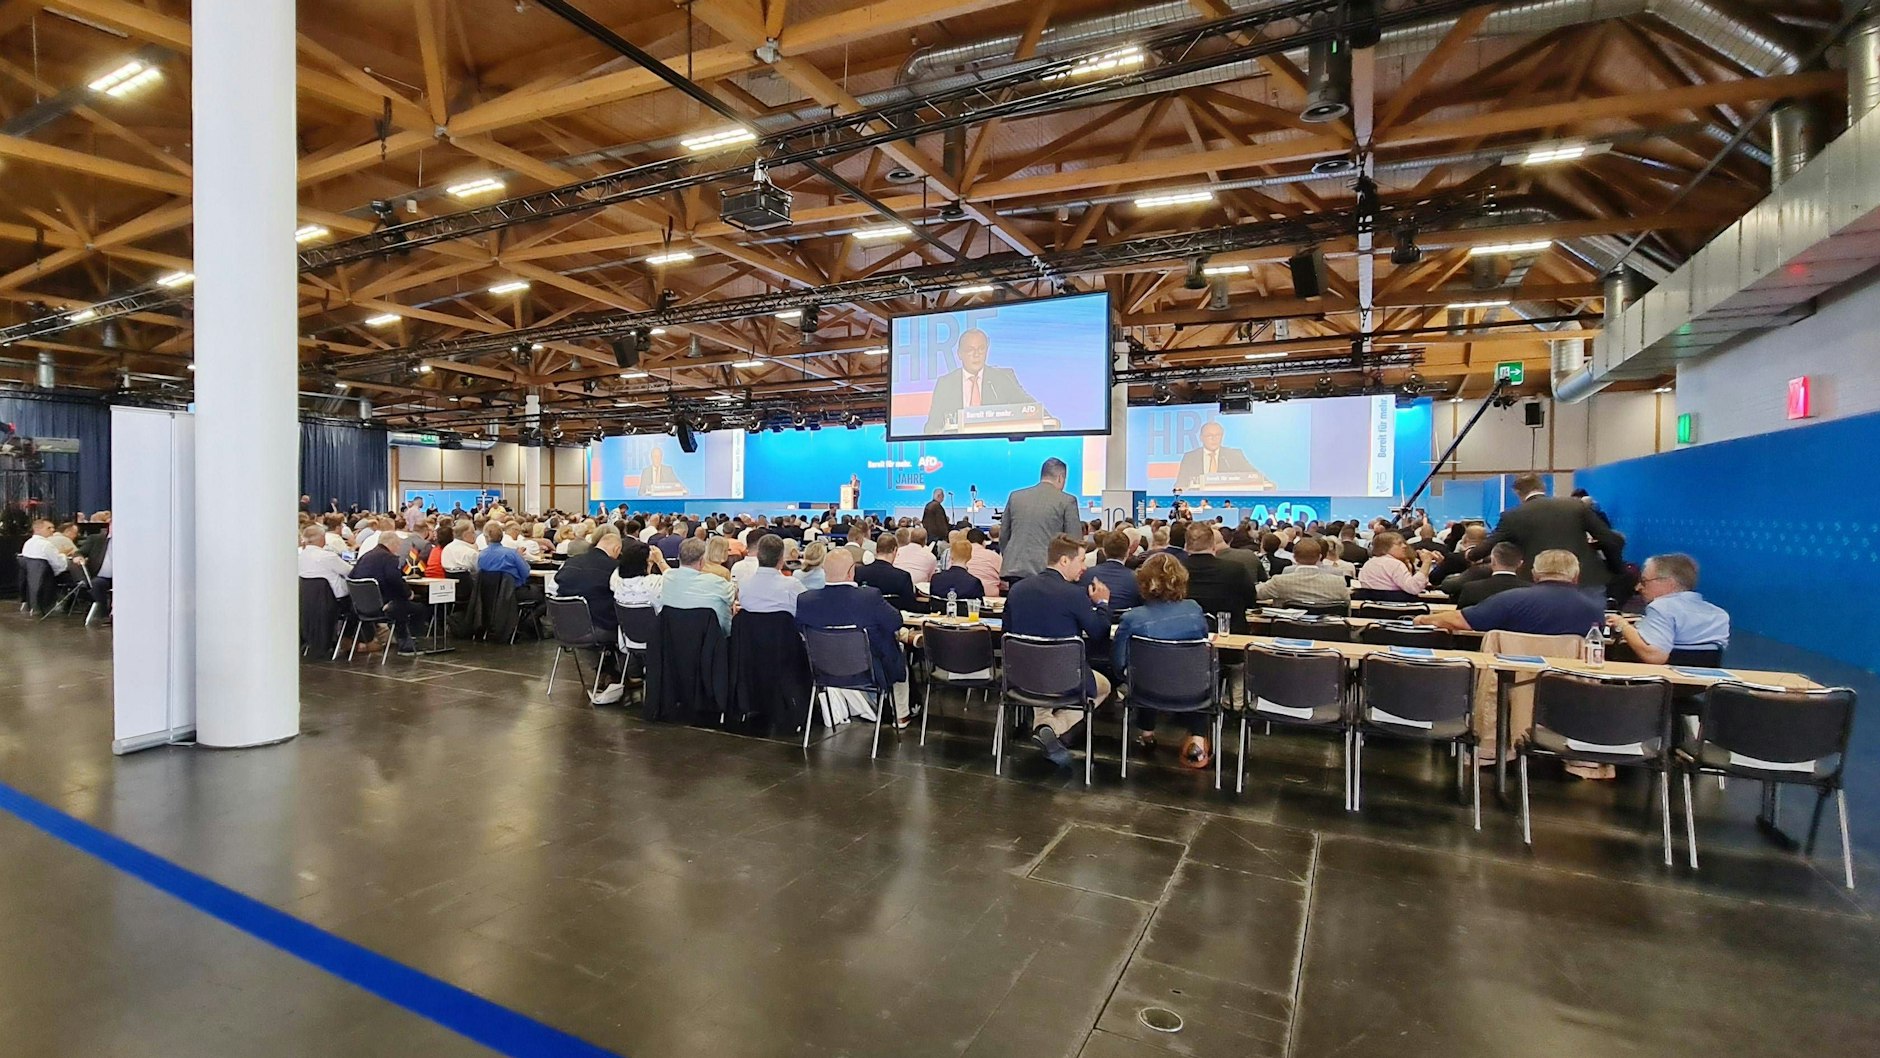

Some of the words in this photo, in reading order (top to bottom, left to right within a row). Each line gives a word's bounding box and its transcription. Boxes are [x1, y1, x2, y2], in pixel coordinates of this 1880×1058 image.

[1378, 396, 1388, 419] mehr.
[1377, 421, 1387, 433] für
[1377, 434, 1387, 458] Bereit
[918, 455, 938, 467] AfD
[896, 473, 925, 484] JAHRE
[1250, 502, 1318, 531] AfD
